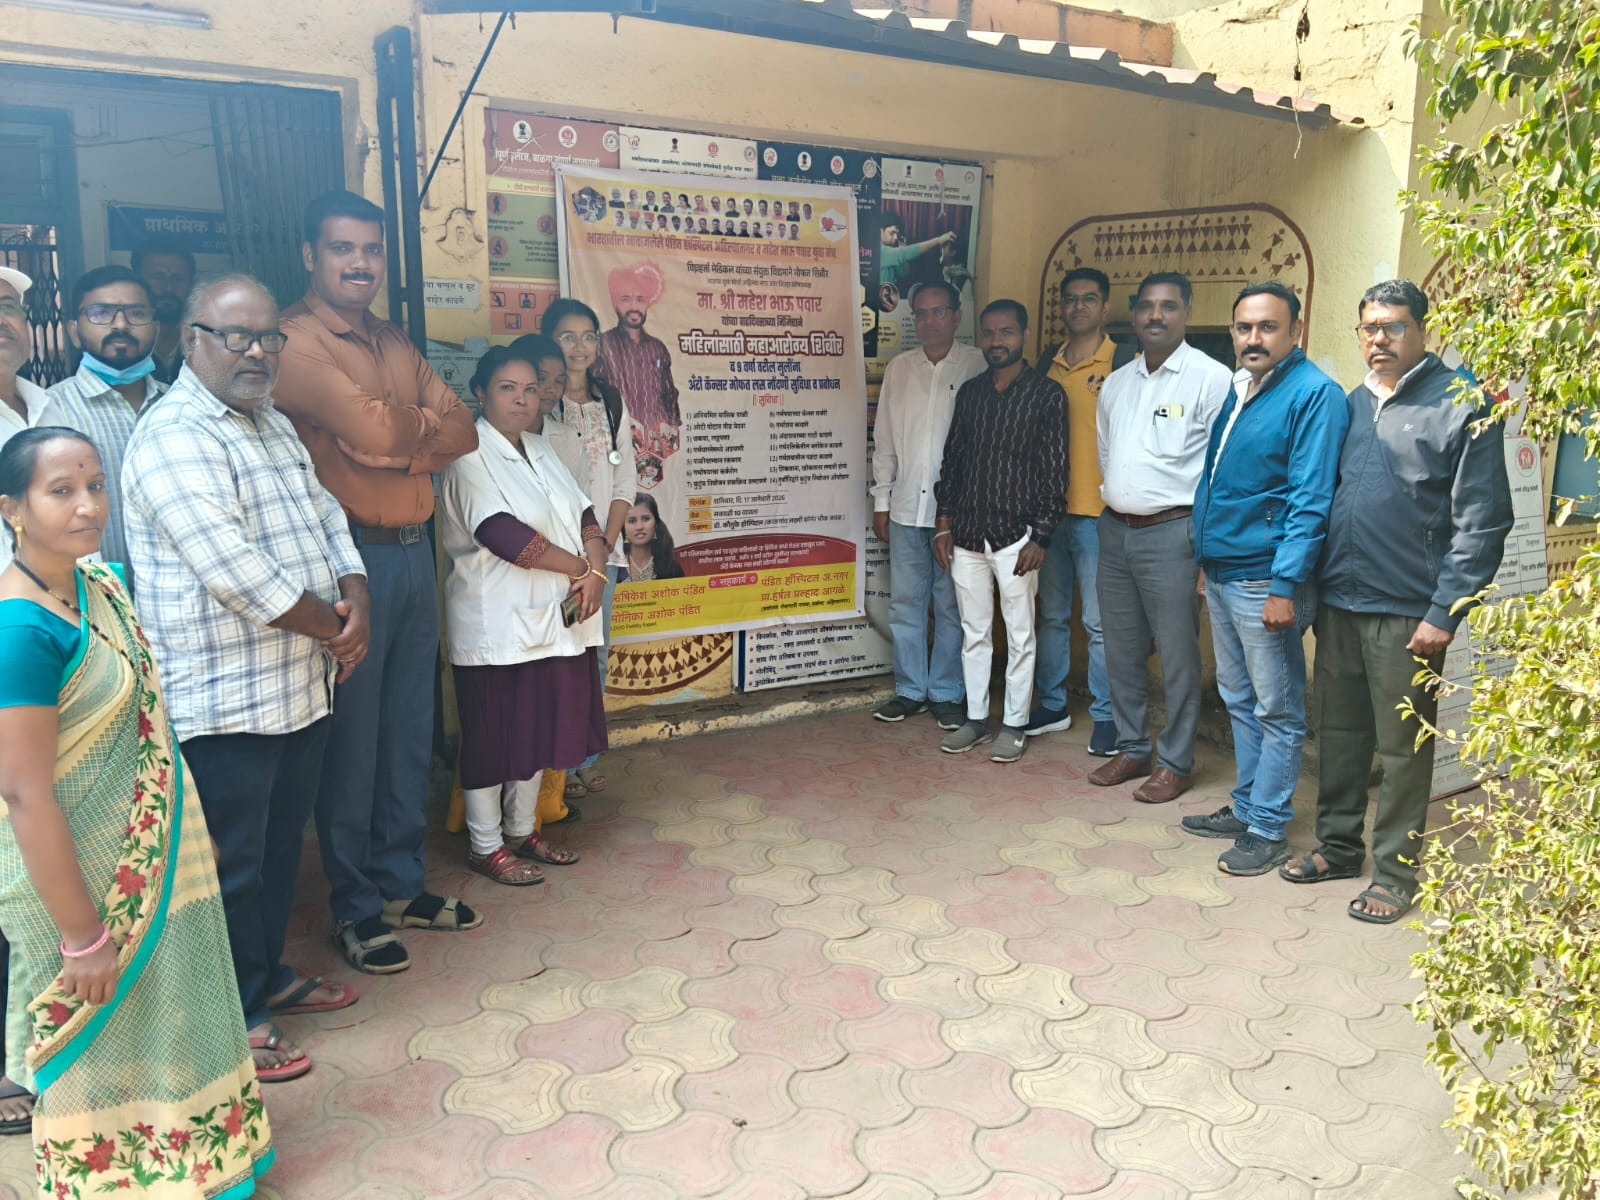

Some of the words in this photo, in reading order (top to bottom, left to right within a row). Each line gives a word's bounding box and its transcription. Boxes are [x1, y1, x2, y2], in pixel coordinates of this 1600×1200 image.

[144, 215, 208, 233] प्राथमिक
[712, 263, 734, 274] मेडिकल
[771, 265, 792, 277] विद्यमाने
[697, 292, 716, 310] मा.
[720, 289, 735, 310] श्री
[737, 290, 767, 311] महेश
[770, 296, 794, 311] भाऊ
[796, 296, 822, 312] पवार
[679, 329, 745, 355] महिलांसाठी
[746, 332, 810, 355] महाआरोग्य
[810, 331, 843, 356] शिबीर
[730, 361, 735, 372] व
[758, 359, 775, 373] वरील
[704, 375, 727, 391] कॅन्सर
[729, 376, 750, 390] मोफत
[752, 378, 765, 390] लस
[767, 376, 789, 391] नोंदणी
[791, 376, 811, 394] सुविधा
[813, 378, 817, 390] व
[819, 376, 840, 390] प्रबोधन
[720, 576, 746, 586] सहकार्य
[762, 575, 782, 586] पंडित
[785, 572, 819, 585] हॉस्पिटल
[822, 571, 848, 581] अ.नगर
[652, 586, 680, 599] अशोक
[683, 584, 705, 595] पंडित
[794, 587, 819, 598] प्रल्हाद
[822, 584, 846, 595] आगळे
[648, 607, 675, 620] अशोक
[679, 605, 701, 616] पंडित
